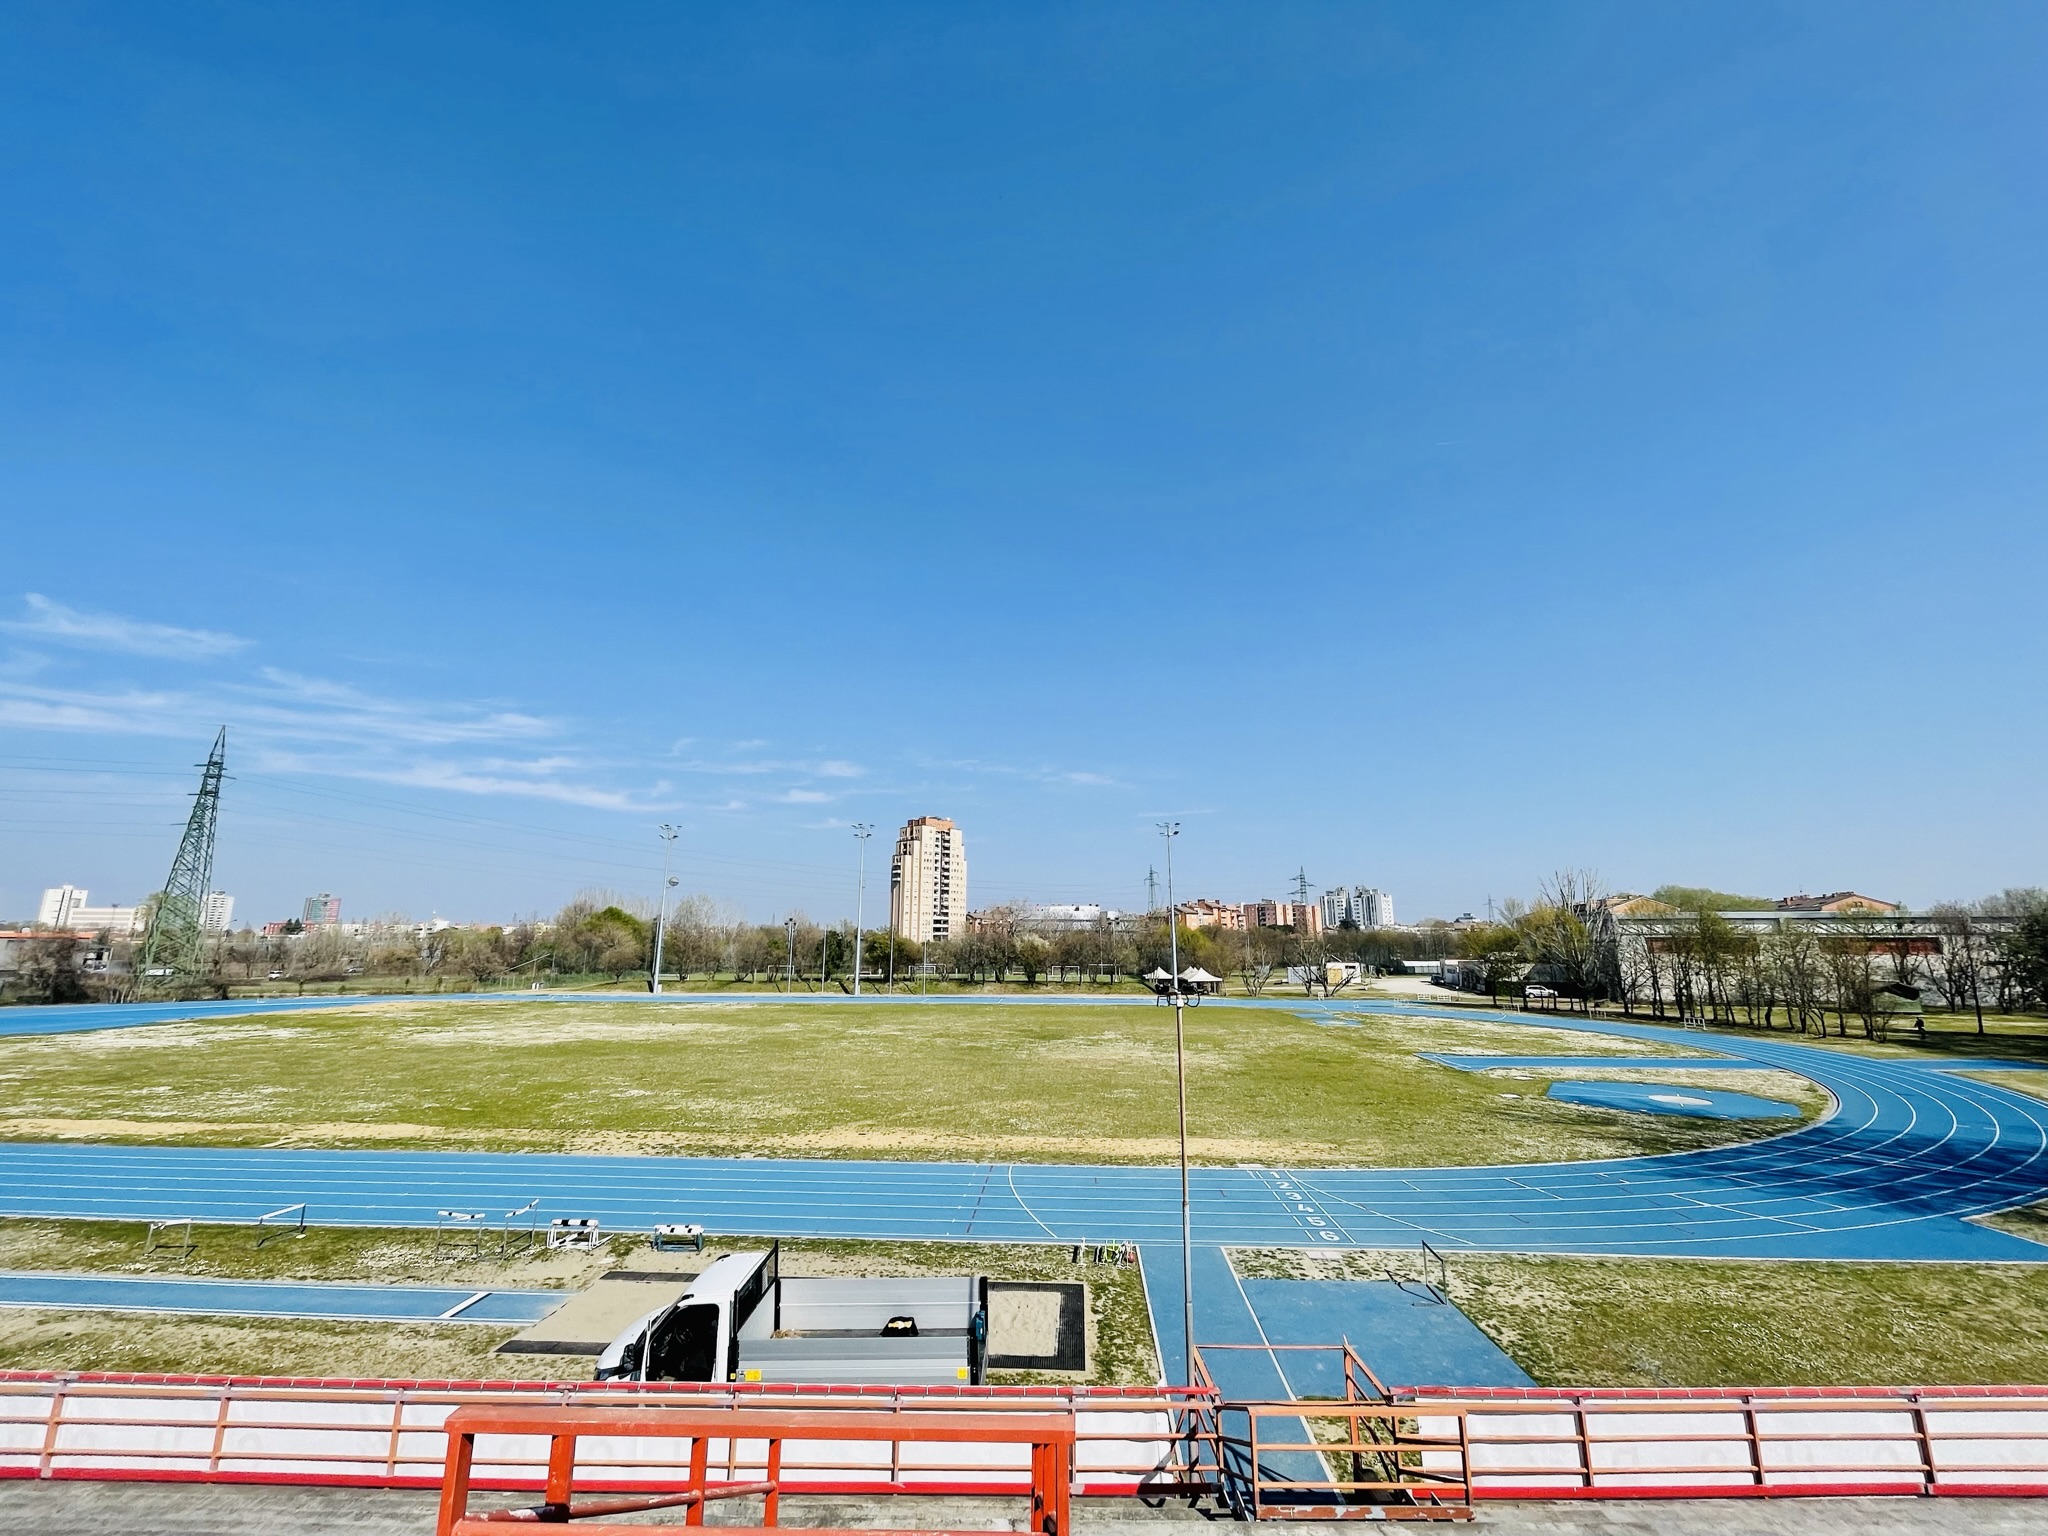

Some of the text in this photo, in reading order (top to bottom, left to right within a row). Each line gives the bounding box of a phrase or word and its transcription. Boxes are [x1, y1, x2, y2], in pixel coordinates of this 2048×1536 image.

[1270, 1171, 1280, 1179] 1
[1276, 1181, 1293, 1189] 2
[1285, 1192, 1302, 1201] 3
[1298, 1204, 1314, 1213] 4
[1306, 1216, 1326, 1226] 5
[1319, 1231, 1340, 1241] 6
